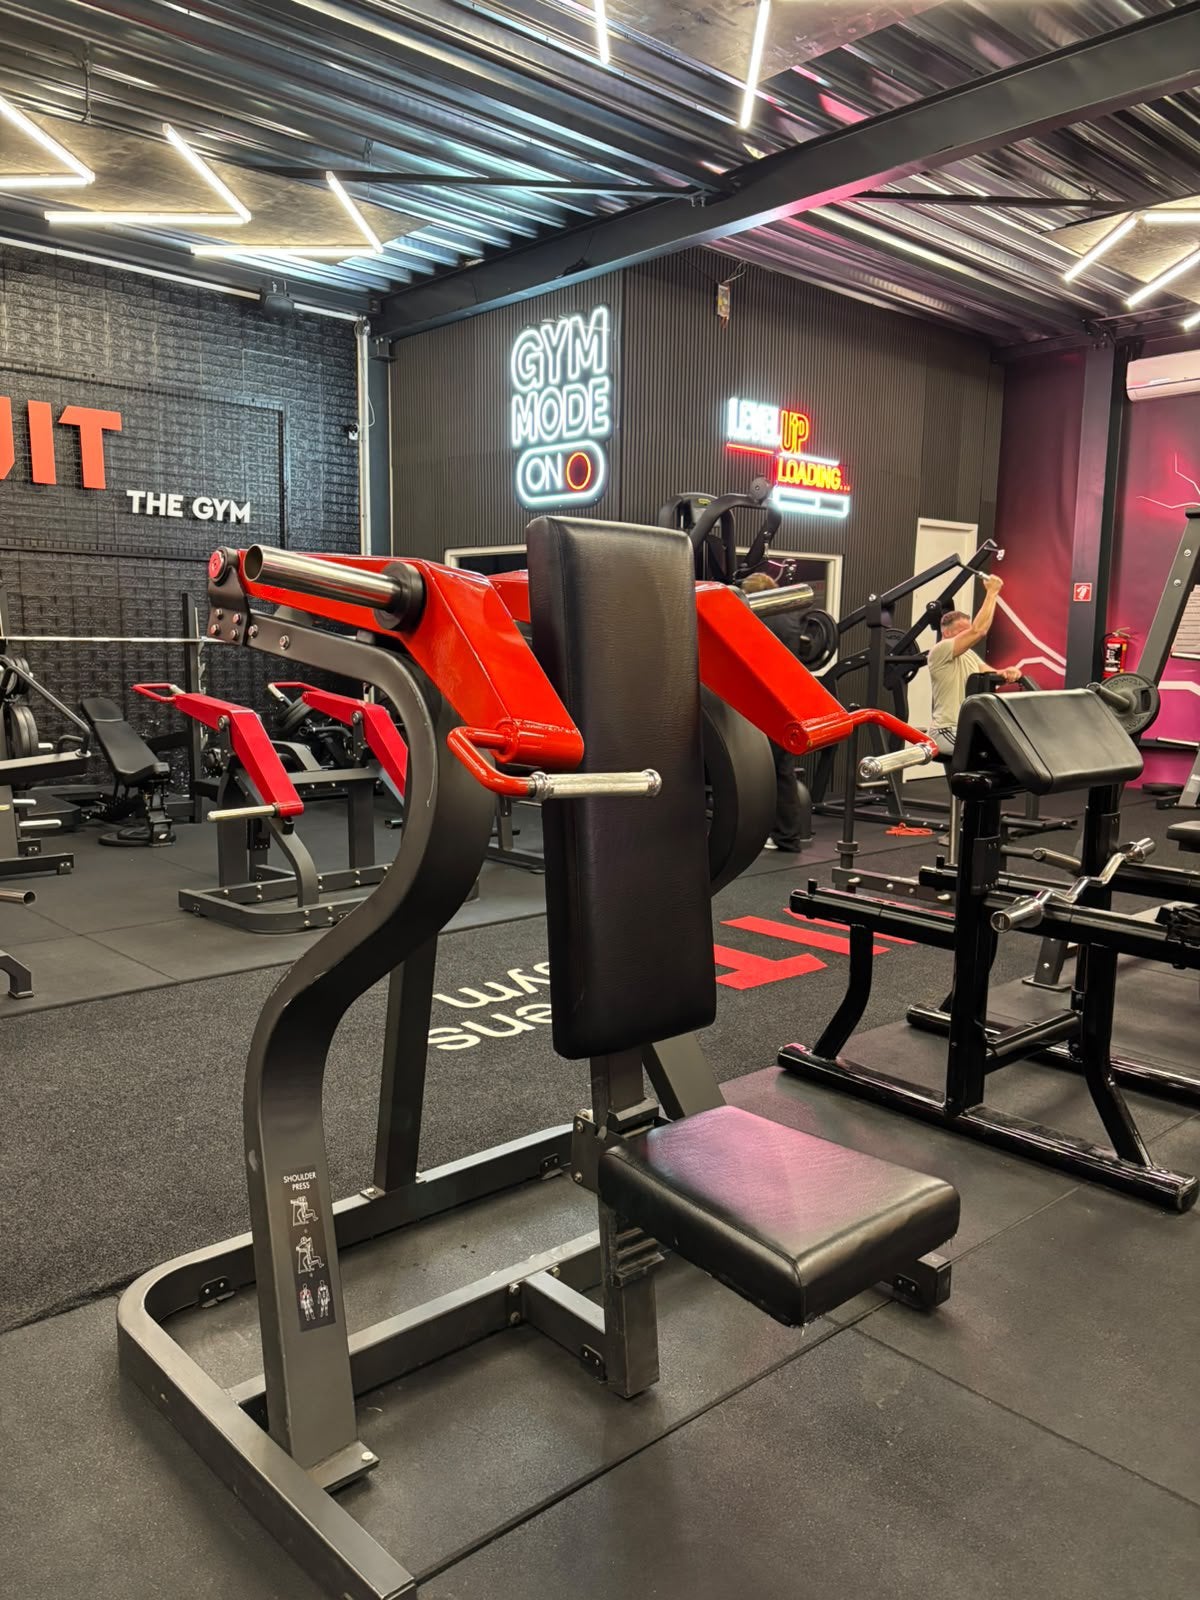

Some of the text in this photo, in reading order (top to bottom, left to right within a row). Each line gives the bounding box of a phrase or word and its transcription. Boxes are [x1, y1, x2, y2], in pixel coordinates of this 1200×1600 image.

[511, 305, 609, 392] GYM
[511, 377, 609, 447] MODE
[728, 397, 809, 454] LEVEL UP
[525, 452, 563, 491] ON
[126, 489, 250, 524] THE GYM
[283, 1171, 317, 1184] SHOULDER
[291, 1181, 311, 1191] PRESS
